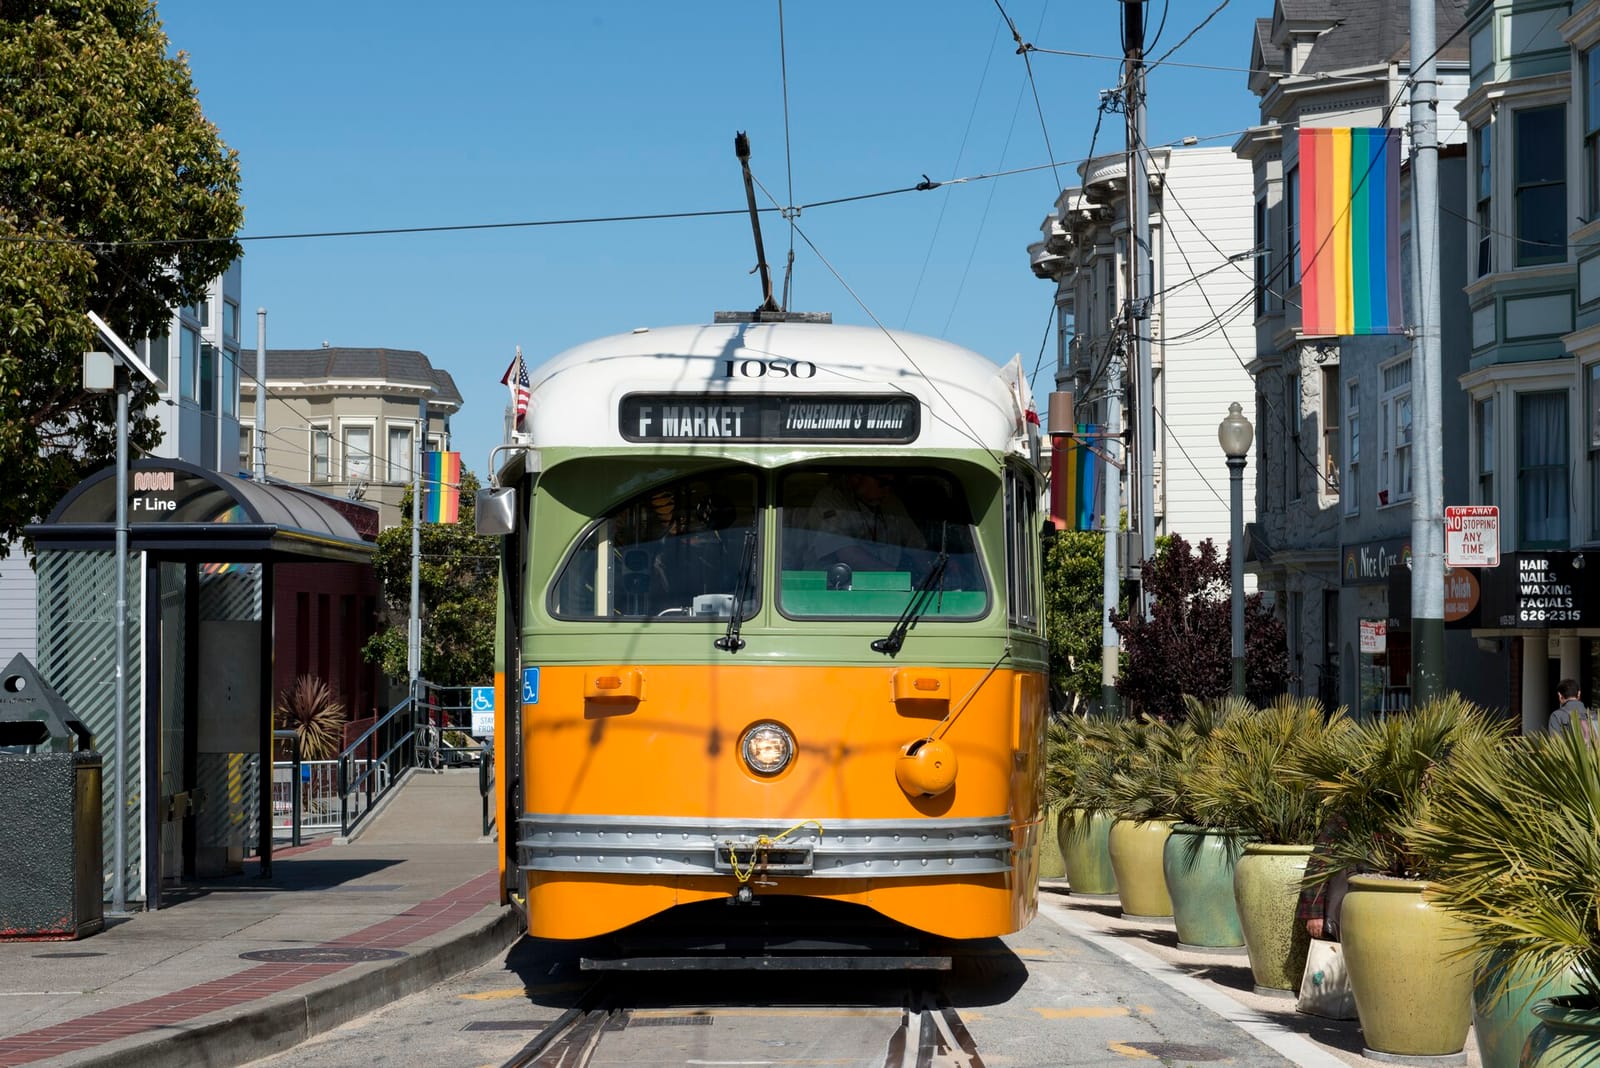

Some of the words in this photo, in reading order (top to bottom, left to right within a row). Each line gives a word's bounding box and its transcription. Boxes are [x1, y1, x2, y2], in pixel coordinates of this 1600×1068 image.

[722, 360, 817, 379] 1080
[639, 406, 652, 437] F
[662, 406, 745, 437] MARKET
[786, 403, 863, 430] FISHERMAN'S
[866, 403, 908, 430] WHARF
[133, 497, 142, 511] F
[145, 497, 177, 511] Line
[1452, 507, 1493, 515] TOW-AWAY
[1447, 516, 1462, 530] NO
[1463, 519, 1496, 530] STOPPING
[1463, 532, 1482, 542] ANY
[1461, 543, 1484, 554] TIME
[1520, 559, 1549, 571] HAIR
[1520, 572, 1558, 583] NAILS
[1520, 584, 1572, 595] WAXING
[1520, 597, 1574, 608] FACIALS
[1520, 609, 1581, 622] 626-2315
